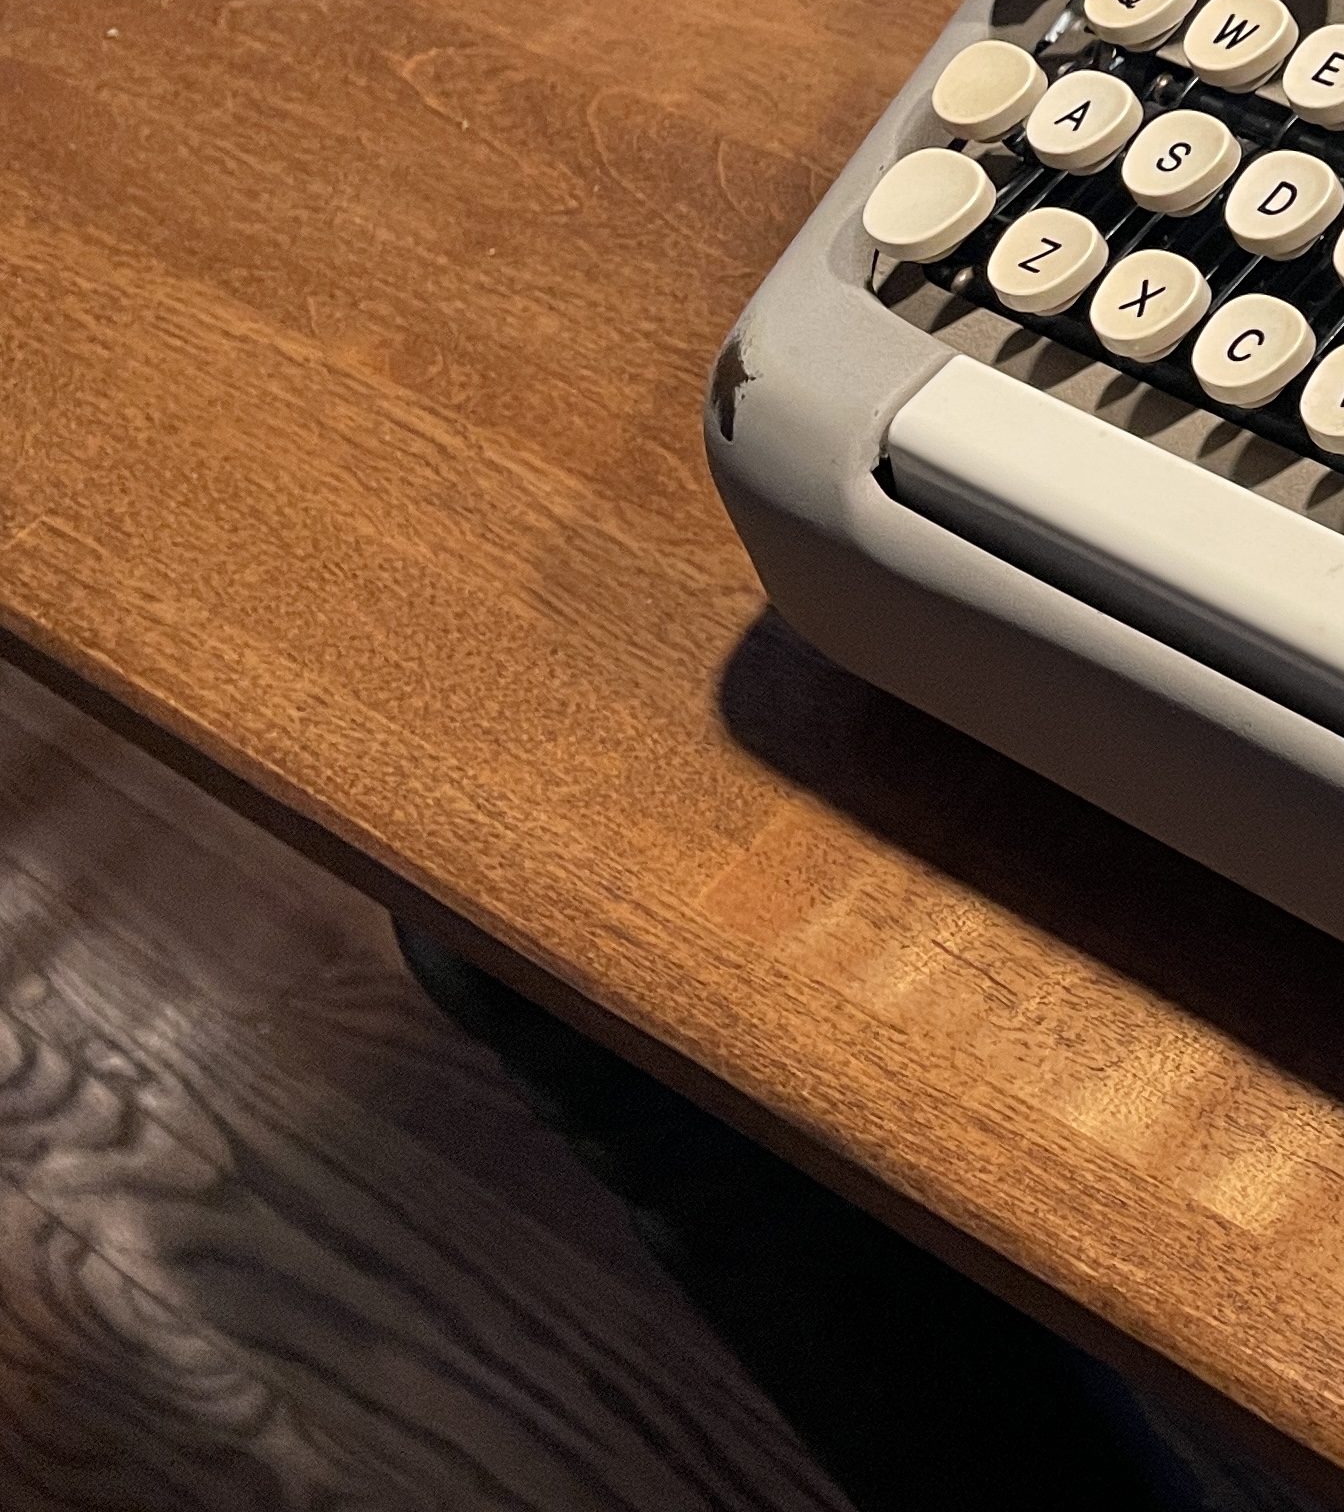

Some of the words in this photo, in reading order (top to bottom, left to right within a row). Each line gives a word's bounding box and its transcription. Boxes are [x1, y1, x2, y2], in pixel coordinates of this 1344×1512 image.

[1213, 13, 1259, 49] W
[1054, 100, 1091, 131] A
[1156, 142, 1191, 171] S
[1257, 181, 1297, 215] D
[1018, 238, 1062, 273] Z
[1119, 280, 1166, 317] X
[1227, 329, 1264, 361] C
